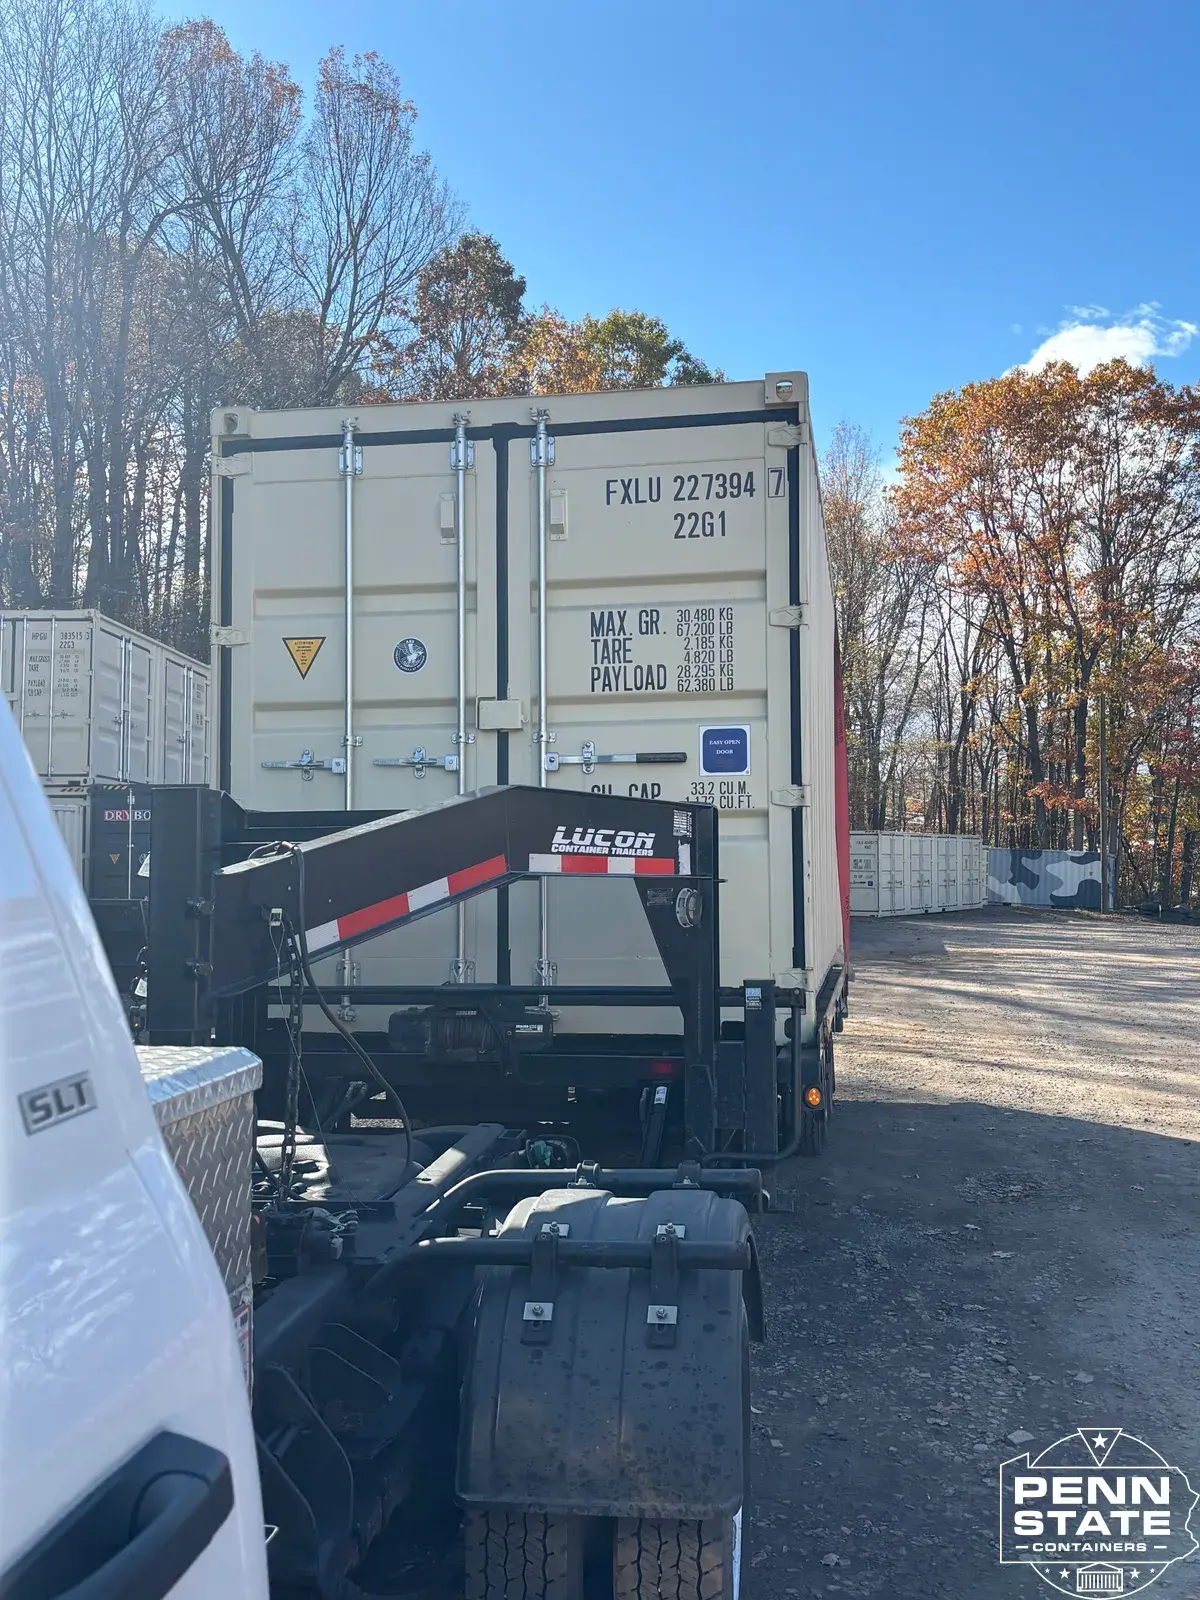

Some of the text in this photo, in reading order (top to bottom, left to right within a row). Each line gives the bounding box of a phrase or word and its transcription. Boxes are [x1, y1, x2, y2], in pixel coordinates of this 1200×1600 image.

[605, 469, 783, 506] FXLU 227394 7
[673, 511, 727, 539] 22G1
[590, 610, 633, 637] MAX.
[638, 609, 667, 635] GR.
[719, 607, 733, 621] KG
[719, 621, 733, 635] LB
[591, 638, 633, 665] TARE
[719, 635, 733, 649] KG
[719, 649, 733, 663] LB
[590, 664, 667, 692] PAYLOAD
[719, 663, 734, 677] KG
[720, 677, 734, 691] LB
[690, 781, 715, 796] 33.2
[551, 843, 654, 857] CONTAINER TRAILERS
[552, 825, 656, 849] LUCON
[29, 1078, 89, 1125] SLT
